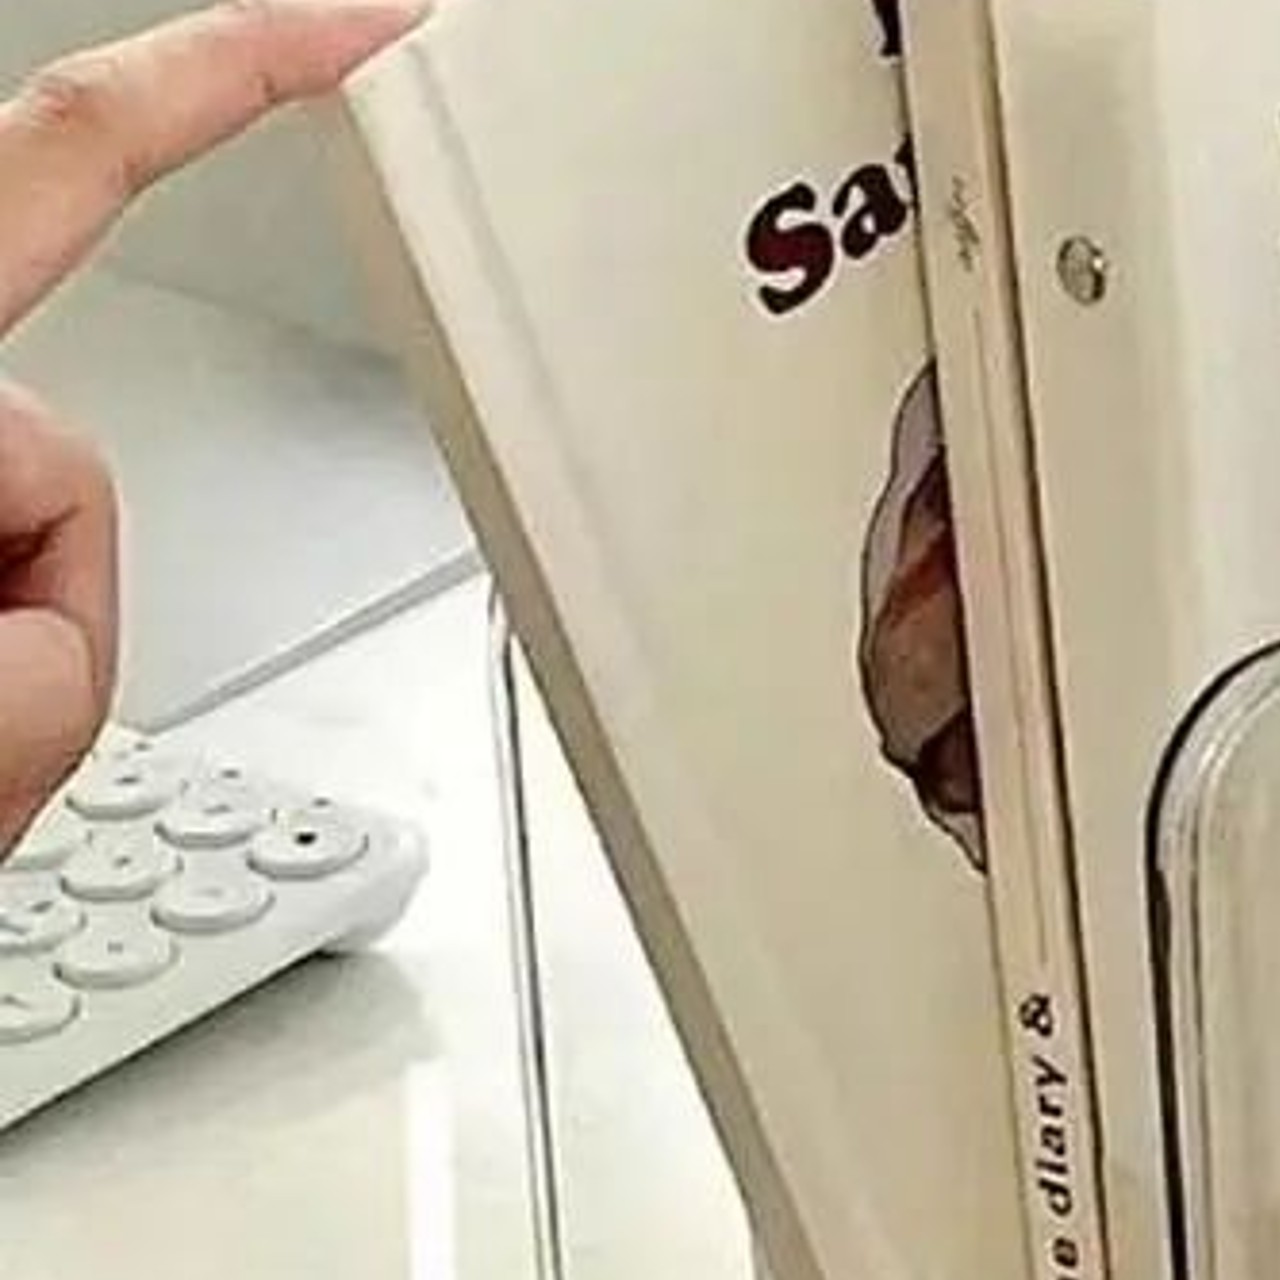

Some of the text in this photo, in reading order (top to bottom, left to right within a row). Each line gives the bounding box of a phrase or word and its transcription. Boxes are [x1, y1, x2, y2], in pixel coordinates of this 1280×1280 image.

[746, 132, 919, 313] Sa
[1018, 992, 1053, 1037] &
[1032, 1056, 1075, 1217] diary
